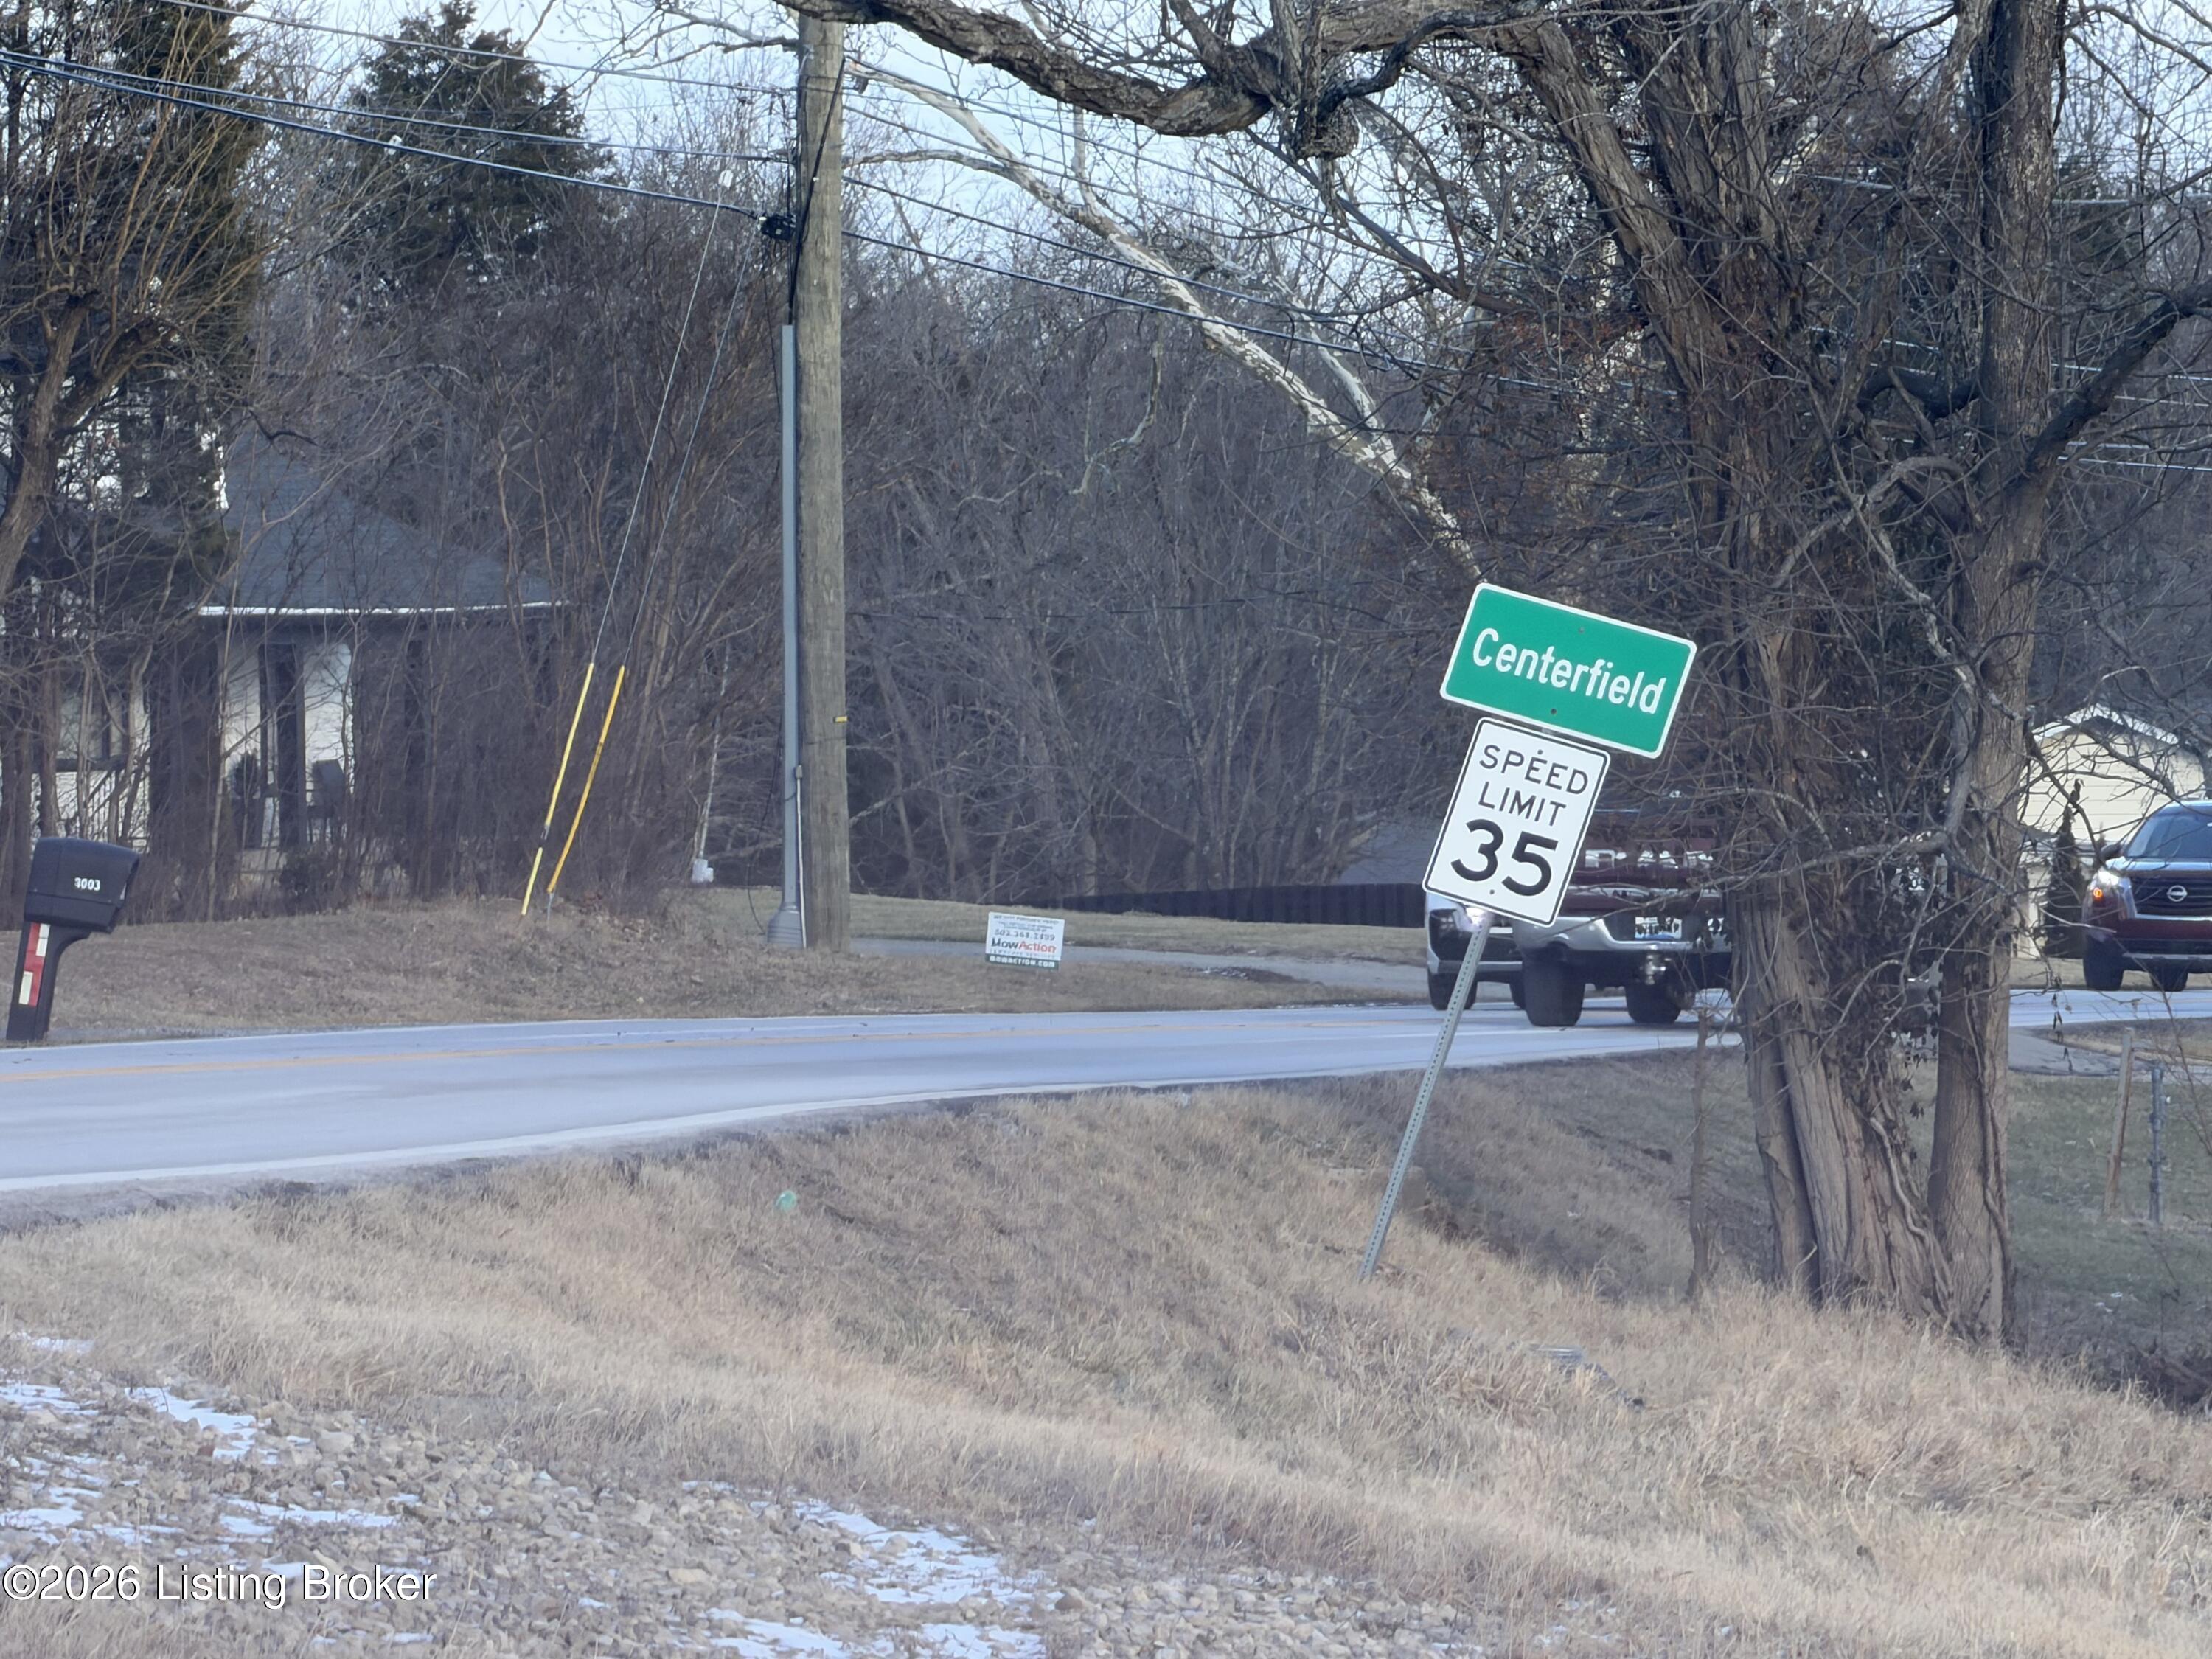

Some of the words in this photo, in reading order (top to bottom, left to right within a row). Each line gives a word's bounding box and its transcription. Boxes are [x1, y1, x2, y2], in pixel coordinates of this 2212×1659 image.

[1472, 627, 1666, 714] Centerfield
[1479, 744, 1589, 796] SPEED
[1478, 781, 1566, 827] LIMIT
[1450, 818, 1559, 897] 35
